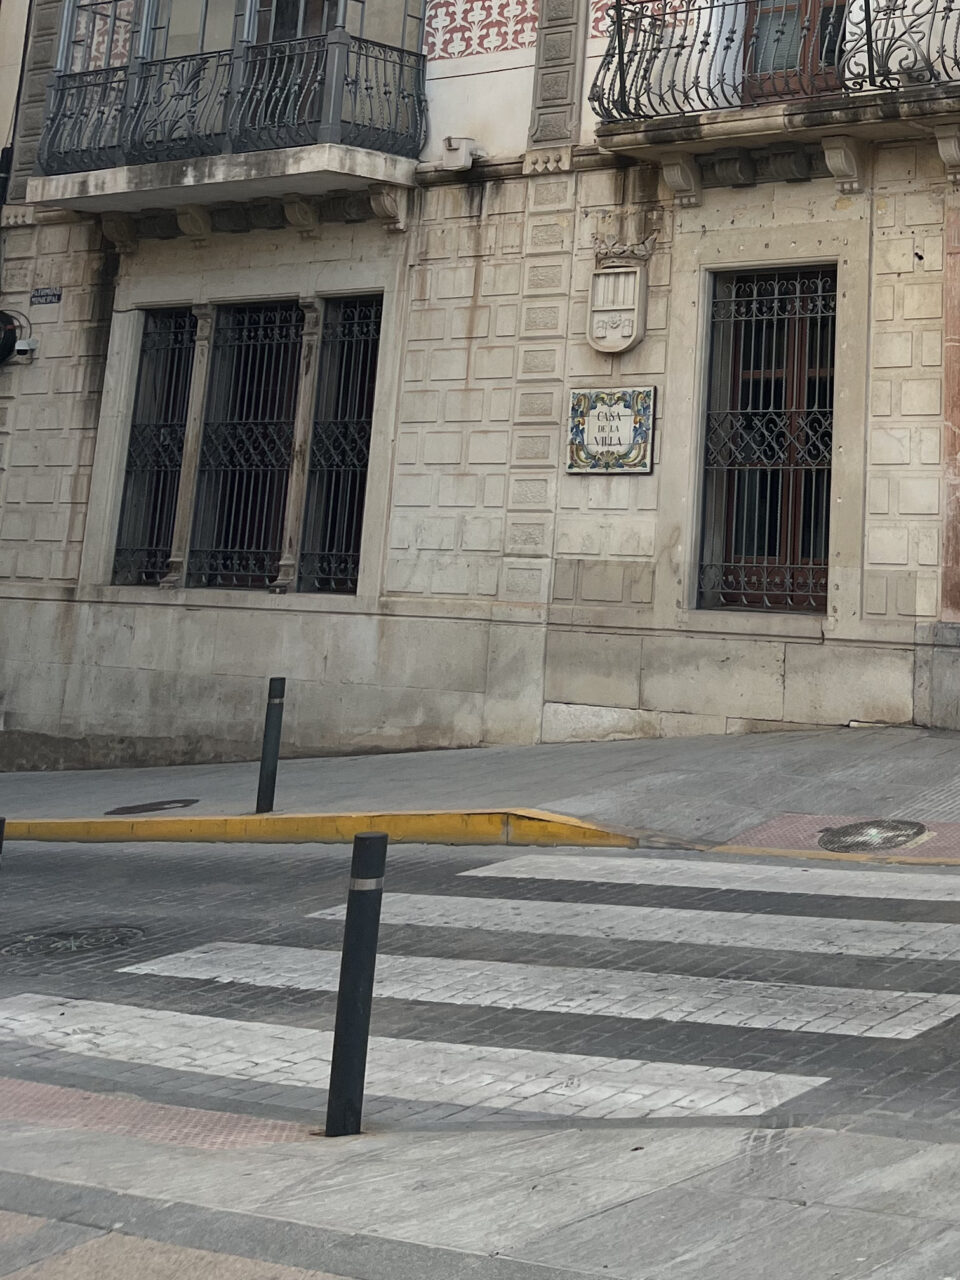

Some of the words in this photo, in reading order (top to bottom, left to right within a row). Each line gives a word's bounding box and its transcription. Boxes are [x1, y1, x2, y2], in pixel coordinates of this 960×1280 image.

[597, 410, 622, 422] CASA
[597, 424, 607, 433] DE
[609, 424, 620, 433] LA
[594, 435, 623, 447] VILLA
